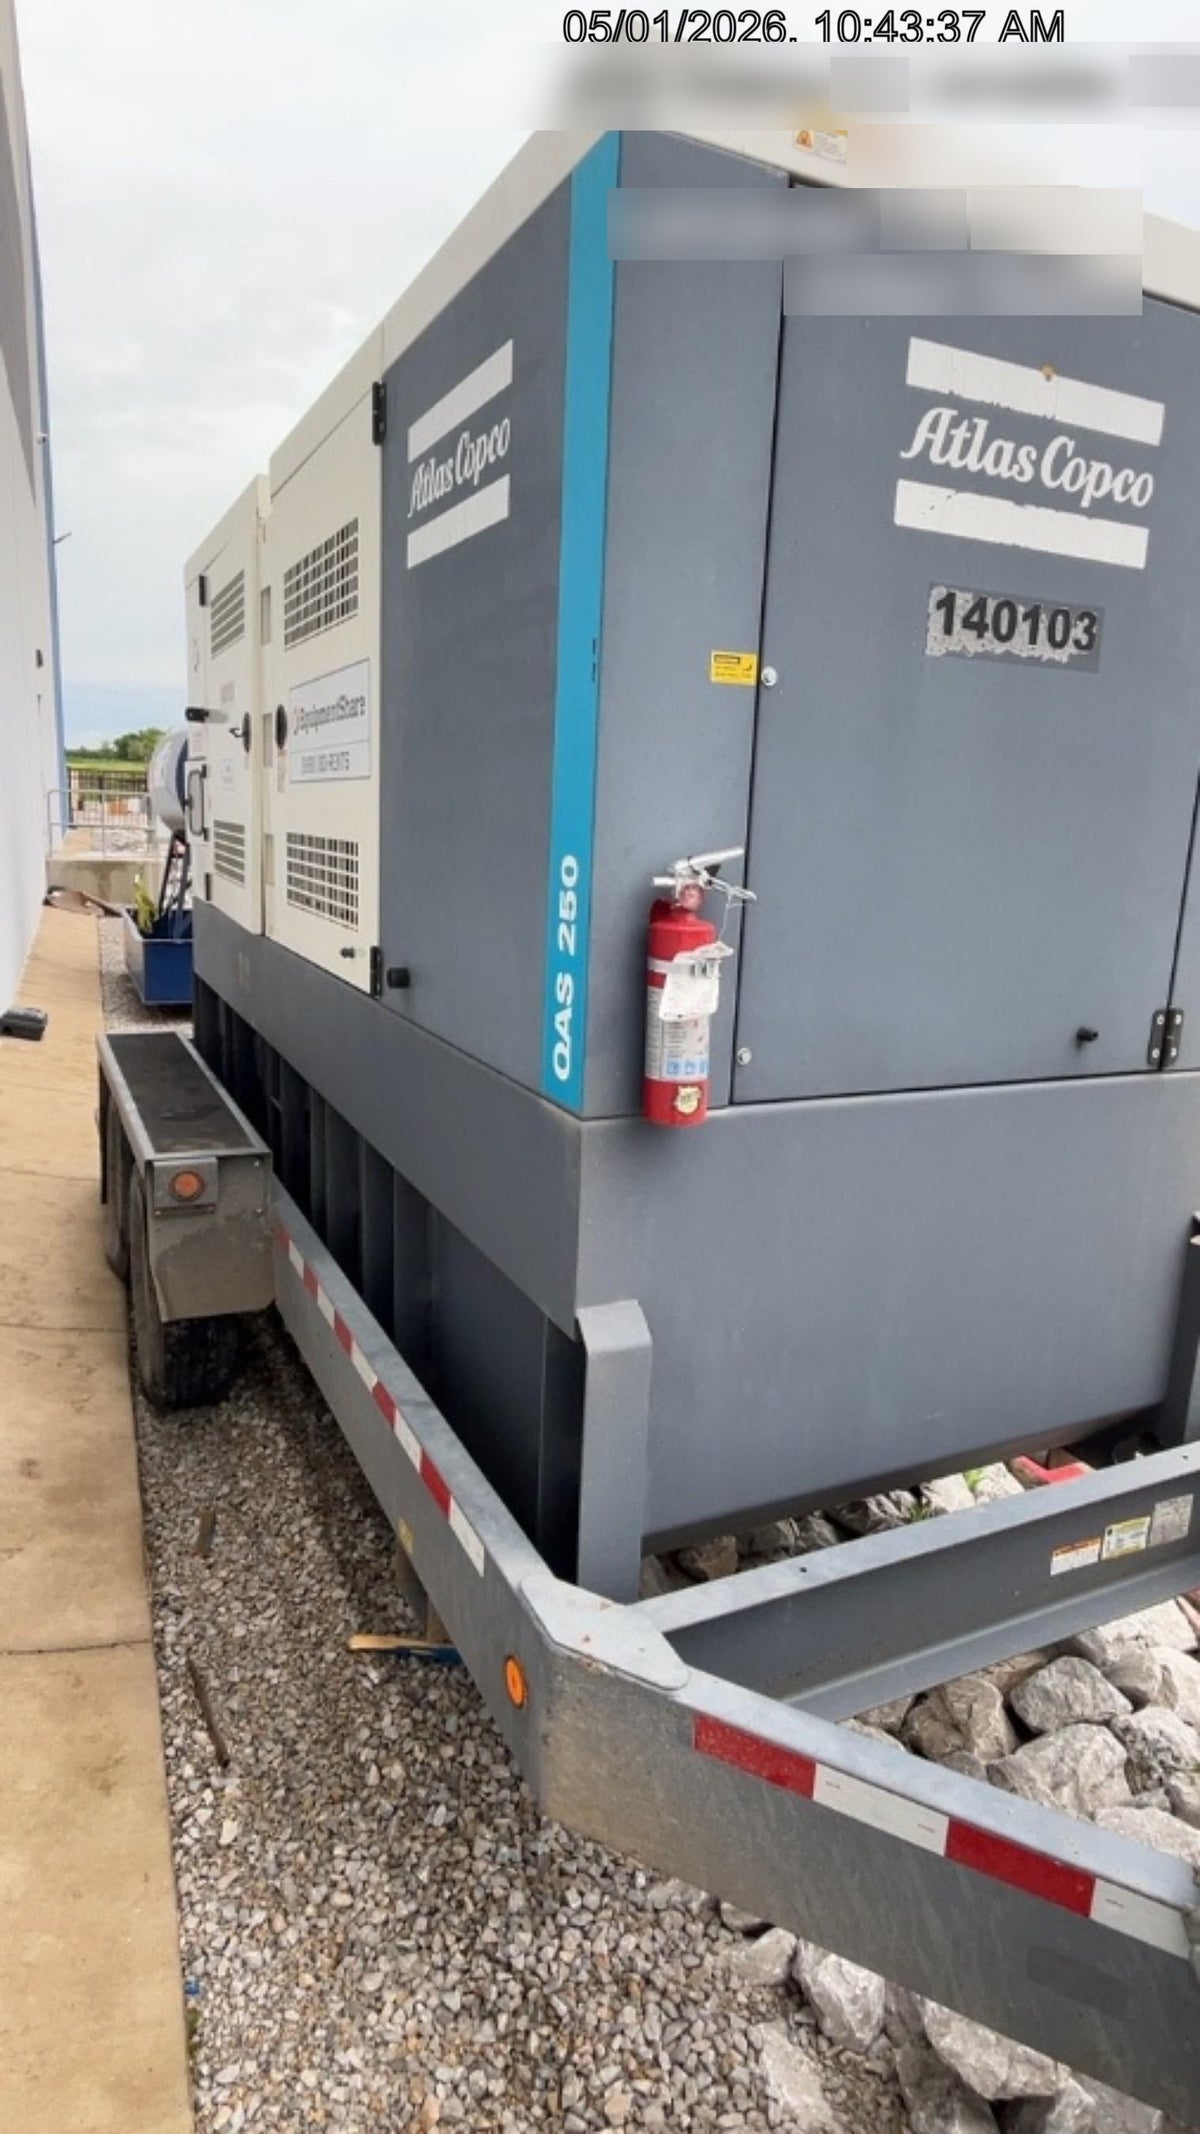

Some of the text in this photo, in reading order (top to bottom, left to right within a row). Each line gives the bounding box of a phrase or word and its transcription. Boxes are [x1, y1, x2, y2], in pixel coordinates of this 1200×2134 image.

[407, 417, 511, 519] Atlas Copco
[900, 406, 1154, 508] Atlas Copco
[935, 591, 1098, 652] 140103
[553, 854, 579, 1083] QAS 250
